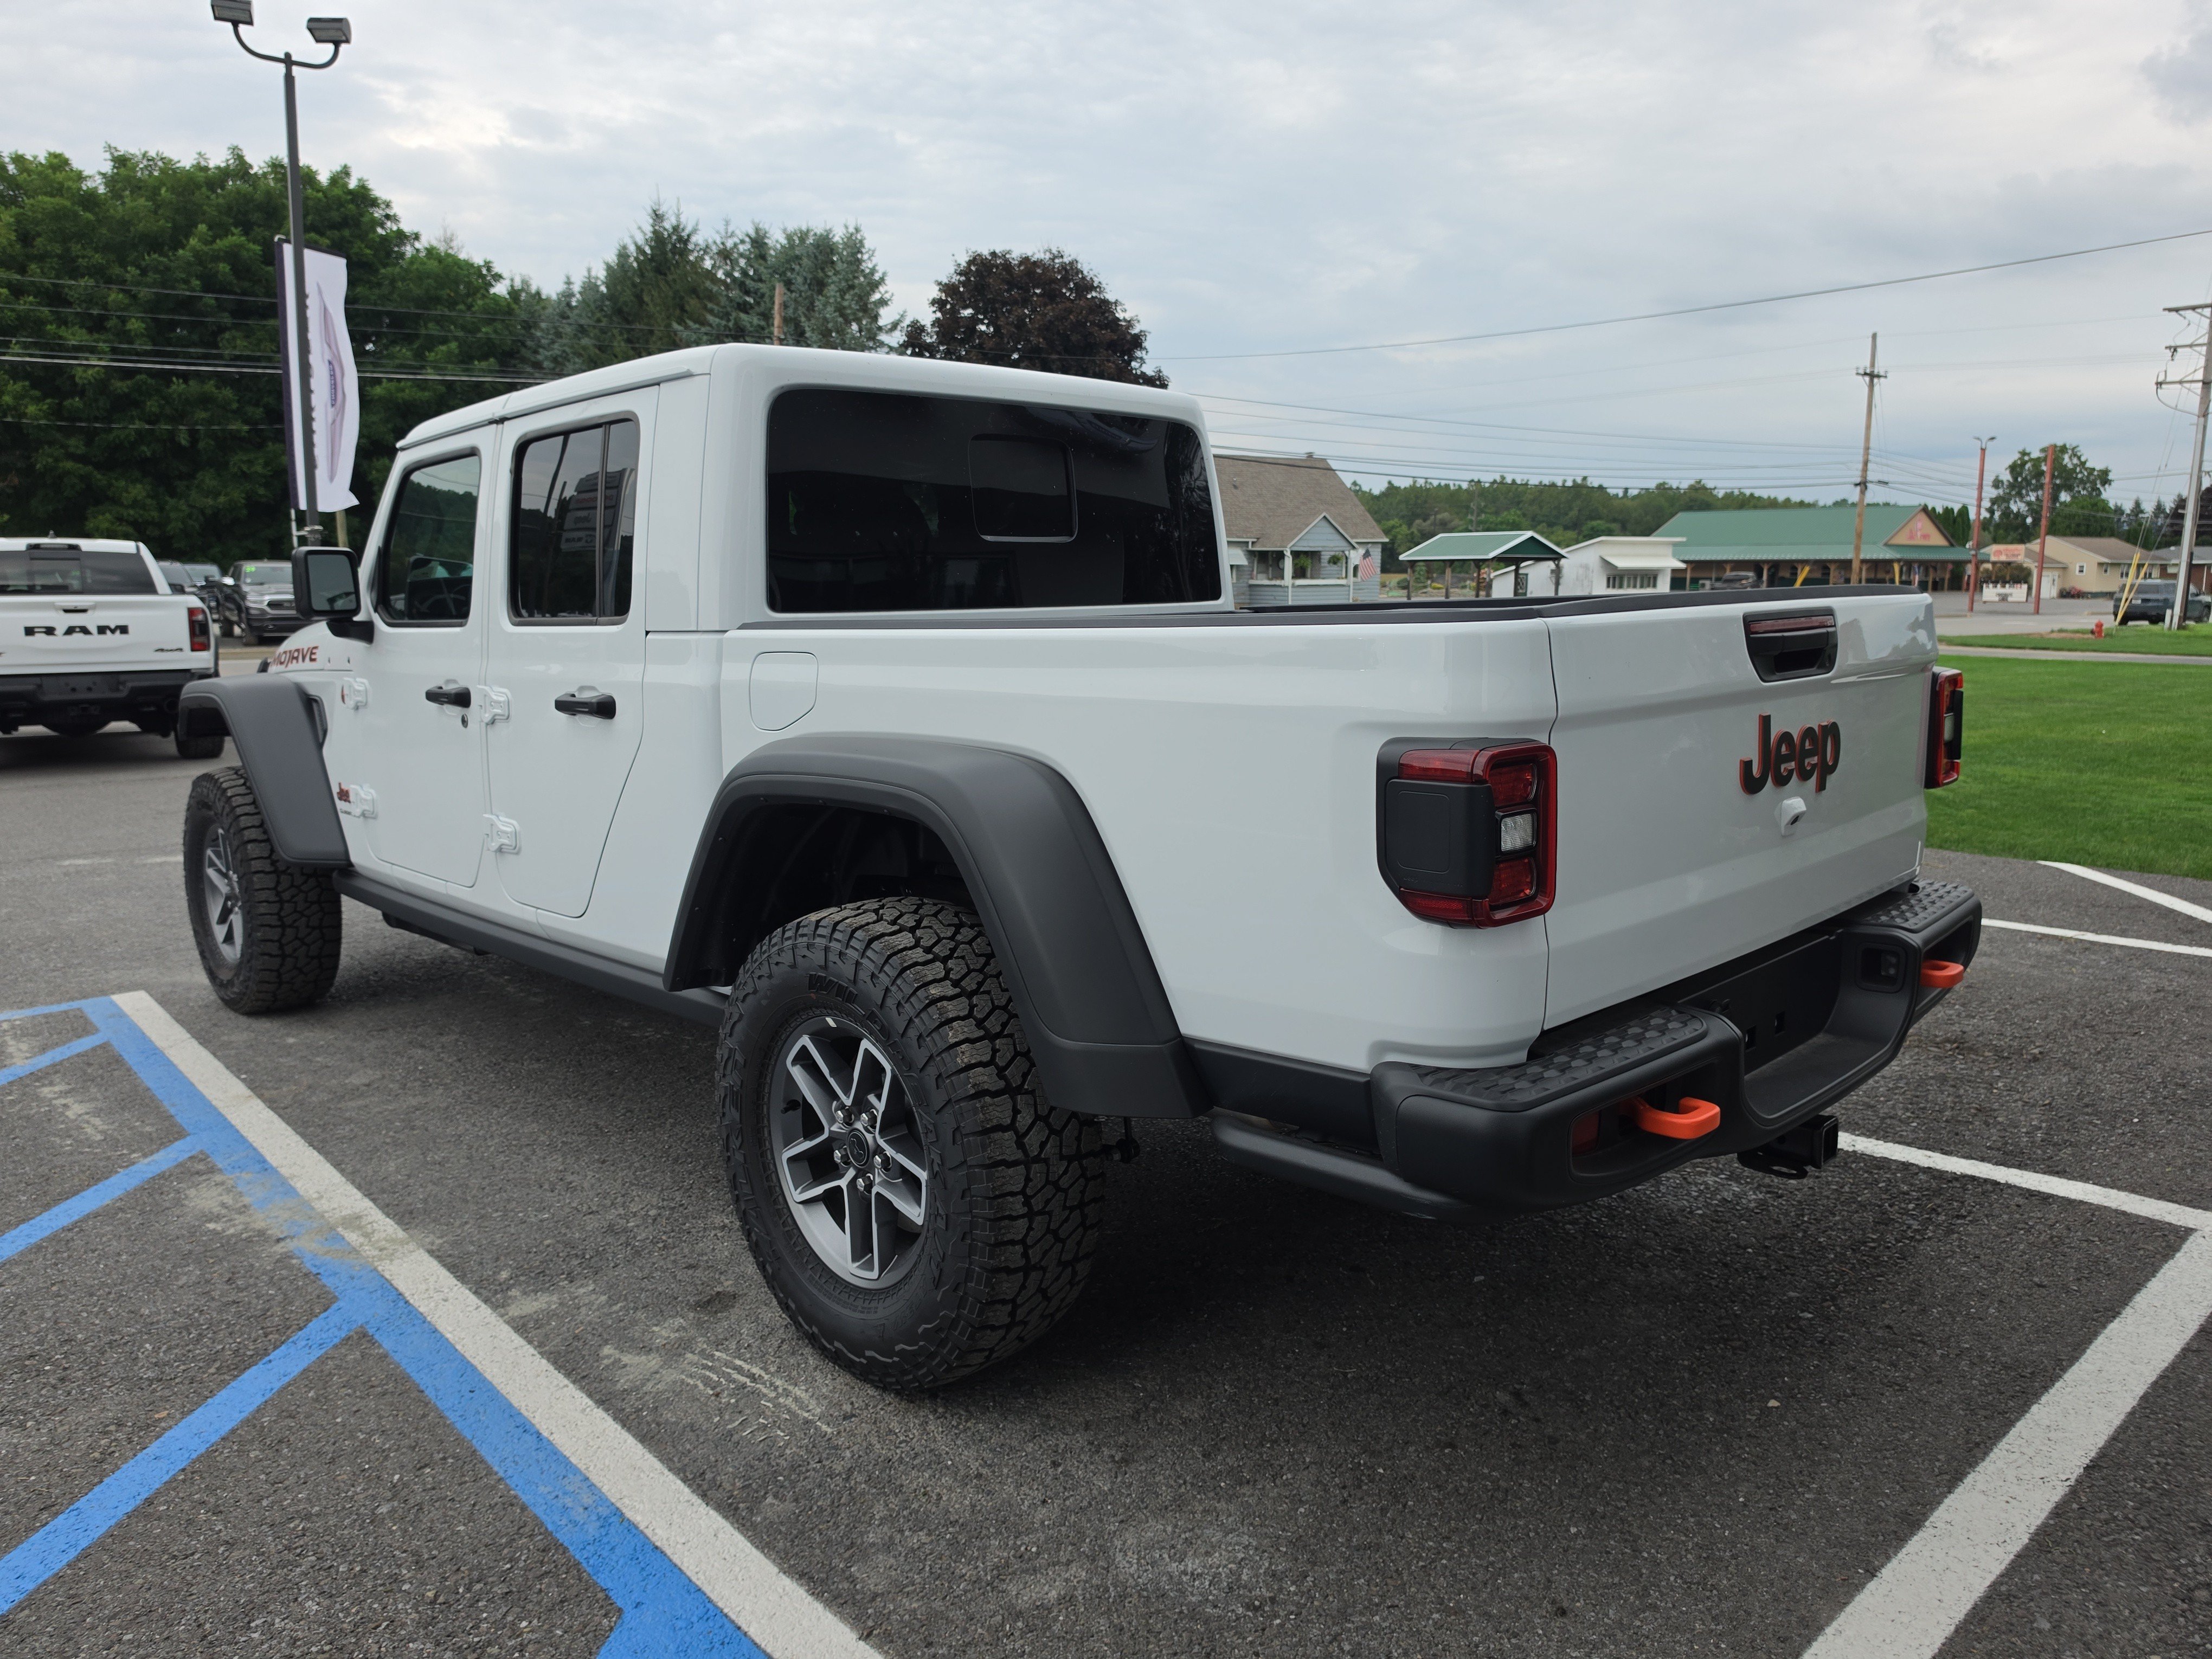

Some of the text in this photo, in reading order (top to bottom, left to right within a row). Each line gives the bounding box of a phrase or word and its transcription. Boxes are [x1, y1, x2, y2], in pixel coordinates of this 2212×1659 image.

[24, 625, 130, 636] RAM
[270, 645, 319, 668] MOJAVE
[1739, 712, 1841, 795] Jeep
